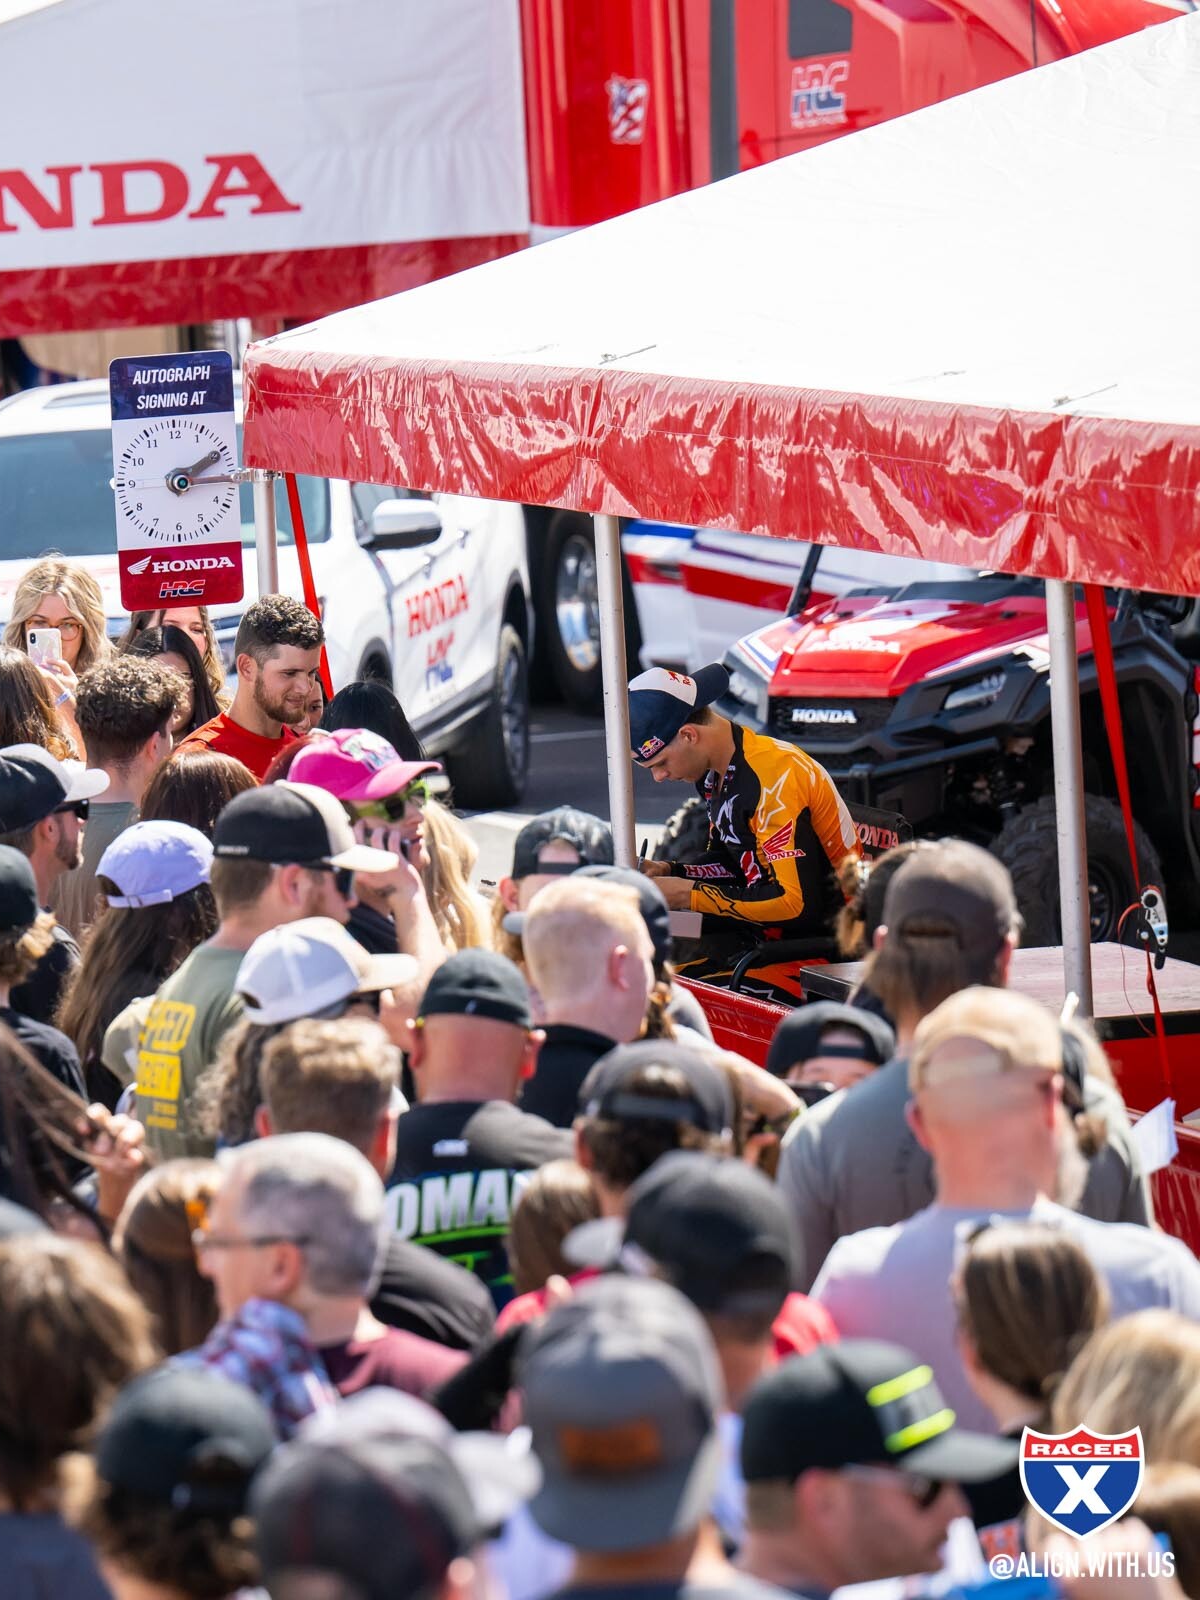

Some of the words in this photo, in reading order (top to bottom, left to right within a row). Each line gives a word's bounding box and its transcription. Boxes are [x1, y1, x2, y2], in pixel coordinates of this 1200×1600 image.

[133, 365, 211, 385] AUTOGRAPH
[137, 392, 188, 409] SIGNING
[190, 391, 207, 406] AT
[169, 431, 182, 439] 12
[195, 435, 200, 443] 1
[147, 440, 158, 448] 11
[132, 458, 144, 466] 10
[128, 480, 136, 488] 9
[213, 496, 219, 504] 4
[136, 503, 143, 511] 8
[153, 518, 159, 526] 7
[197, 514, 204, 522] 5
[176, 522, 182, 530] 6
[152, 556, 235, 573] HONDA
[159, 579, 206, 598] HRC
[404, 573, 469, 638] HONDA
[792, 708, 857, 724] HONDA
[853, 821, 899, 849] ONDA
[683, 863, 735, 878] HON
[382, 1168, 538, 1240] OMA
